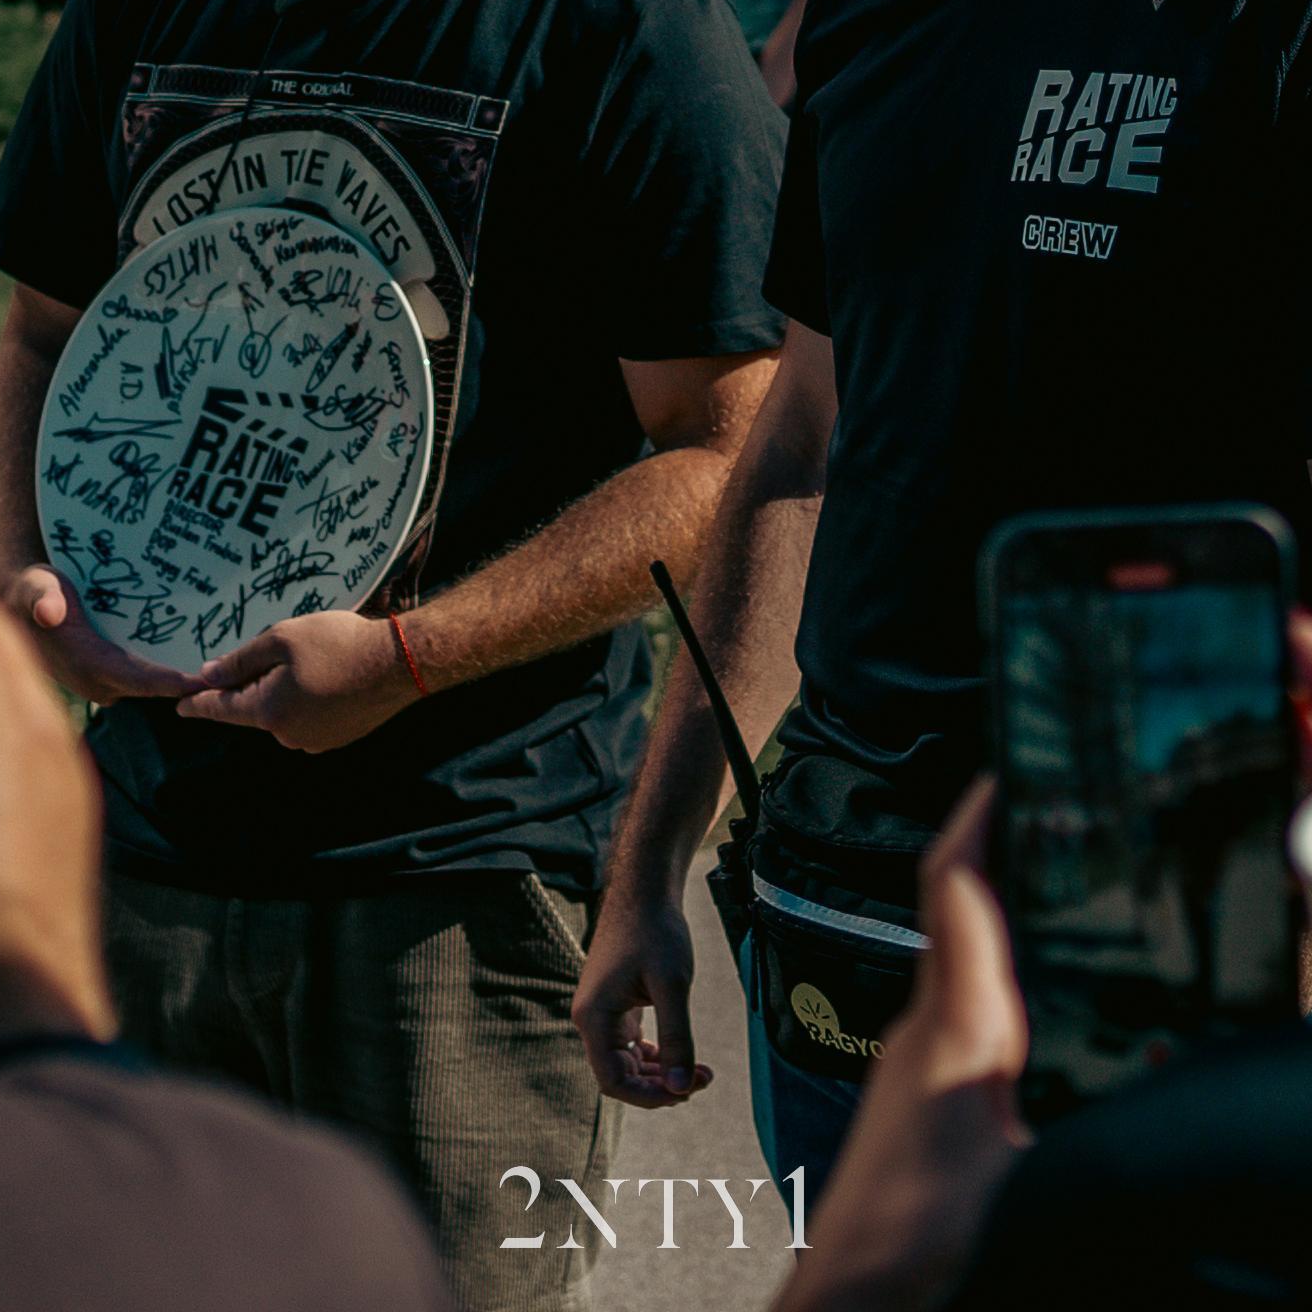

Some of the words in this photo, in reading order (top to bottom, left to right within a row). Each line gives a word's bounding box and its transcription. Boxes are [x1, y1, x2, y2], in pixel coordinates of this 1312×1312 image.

[271, 79, 297, 94] THE
[1019, 70, 1177, 142] RATING
[1011, 118, 1170, 193] RACE
[232, 153, 267, 194] IN
[336, 160, 410, 266] WAVES
[1022, 215, 1117, 258] CREW
[180, 415, 299, 484] RATING
[167, 470, 287, 538] RACE
